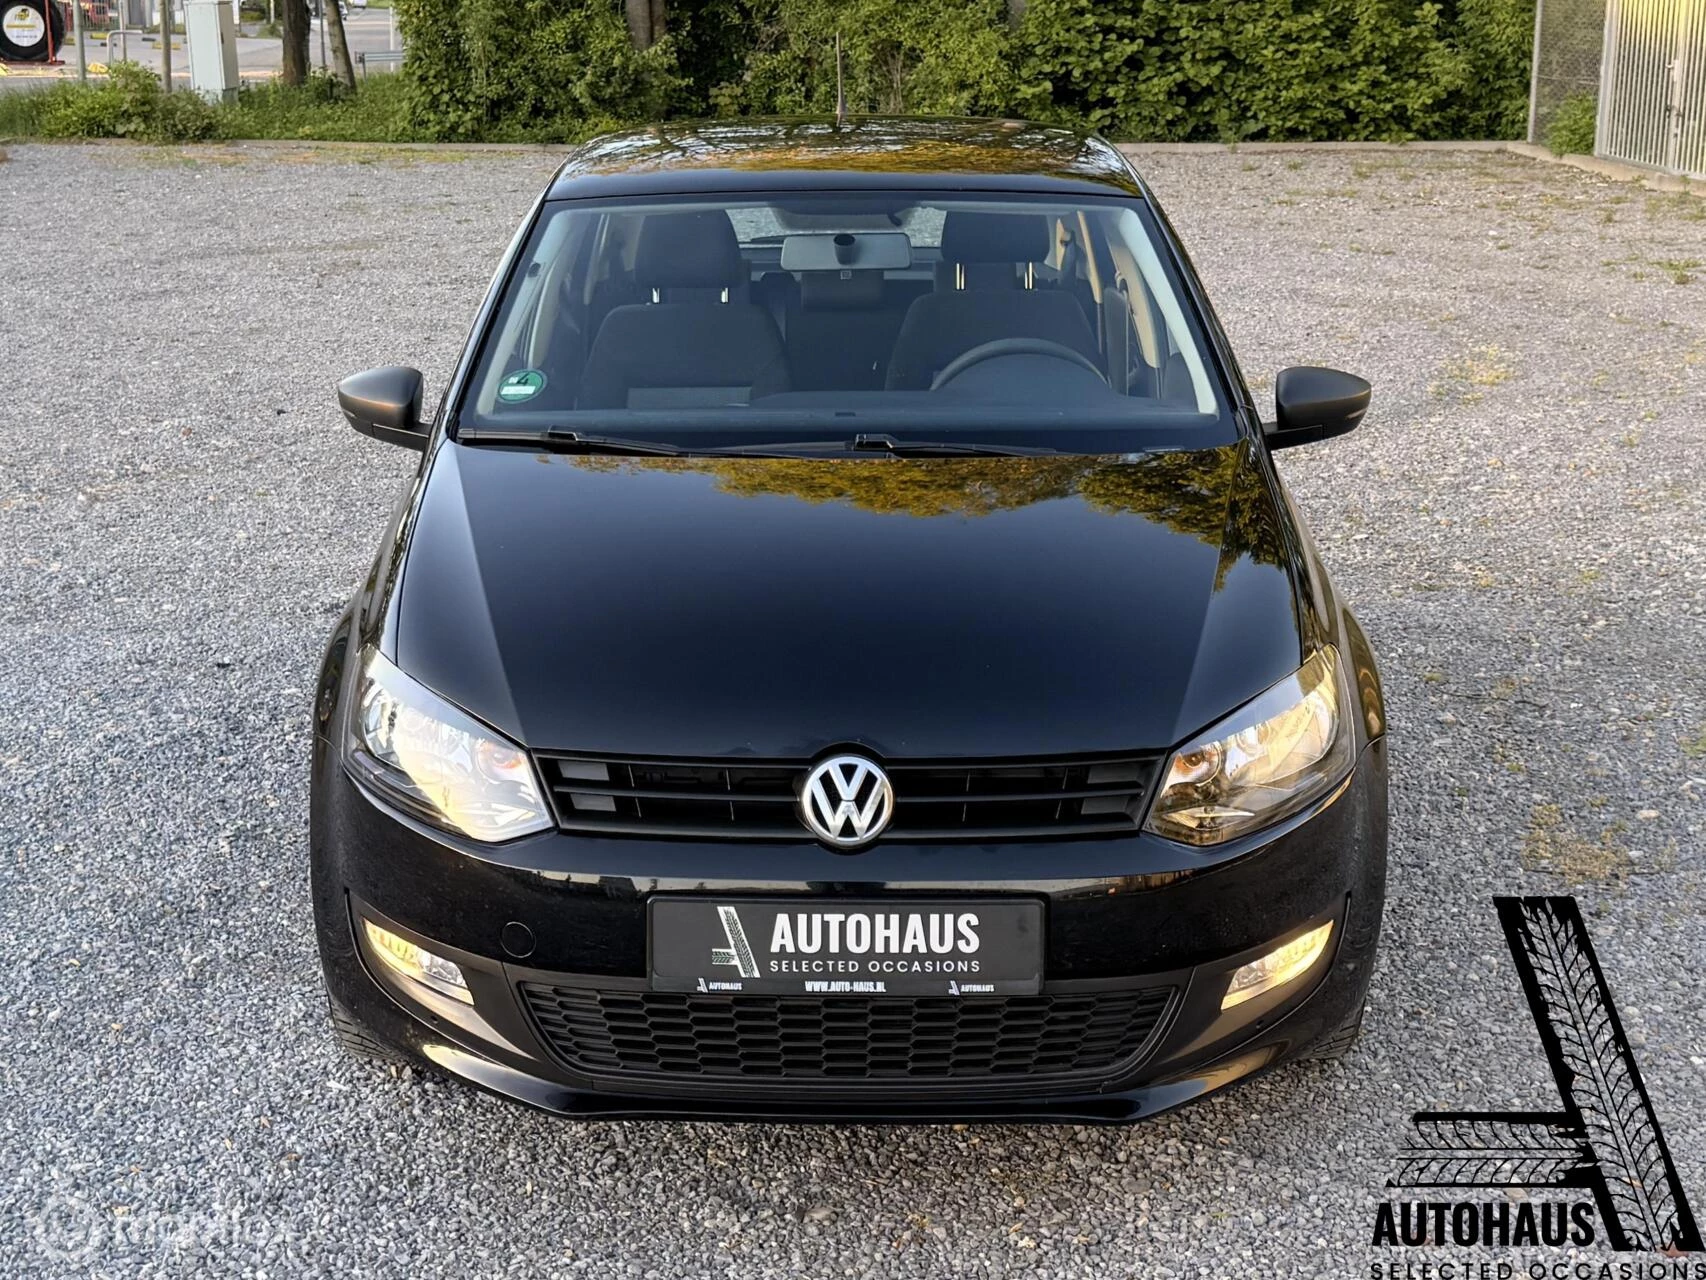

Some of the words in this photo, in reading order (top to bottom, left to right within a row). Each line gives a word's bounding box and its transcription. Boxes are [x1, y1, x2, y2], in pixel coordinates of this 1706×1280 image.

[770, 913, 980, 954] AUTOHAUS
[770, 960, 860, 973] SELECTED
[868, 960, 981, 973] OCCASIONS
[804, 980, 887, 993] WWW.AUTO-HAUS.NL
